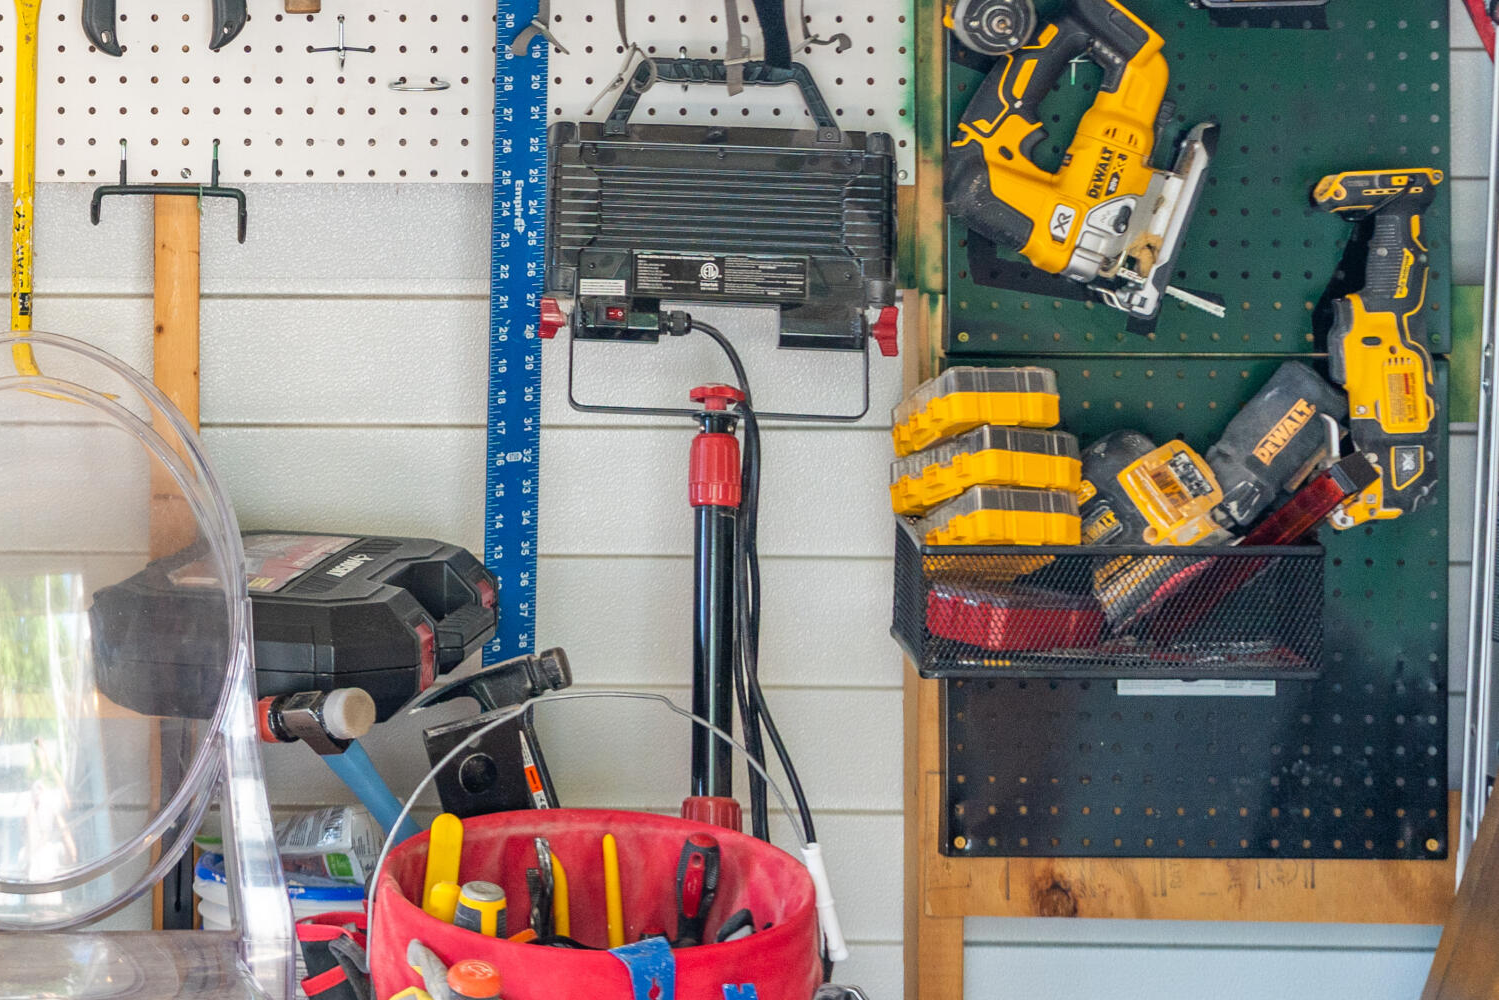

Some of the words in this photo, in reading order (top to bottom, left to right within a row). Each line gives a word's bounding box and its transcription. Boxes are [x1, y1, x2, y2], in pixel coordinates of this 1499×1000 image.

[505, 13, 514, 28] 30
[504, 45, 513, 59] 29
[531, 44, 540, 58] 19
[504, 76, 513, 91] 28
[530, 75, 540, 89] 20
[503, 108, 512, 121] 27
[530, 106, 539, 119] 21
[502, 139, 511, 153] 26
[530, 137, 538, 152] 22
[502, 170, 511, 185] 25
[529, 168, 538, 183] 23
[1087, 147, 1113, 199] DEWALT
[501, 201, 510, 216] 24
[513, 180, 524, 231] Empire
[528, 200, 537, 215] 24
[1054, 212, 1073, 234] XR
[500, 233, 509, 248] 23
[528, 231, 536, 245] 25
[500, 264, 509, 279] 22
[527, 262, 536, 277] 26
[499, 295, 508, 309] 21
[526, 293, 535, 307] 27
[499, 326, 508, 341] 20
[525, 324, 534, 339] 28
[498, 359, 507, 373] 19
[525, 355, 534, 370] 29
[497, 390, 506, 404] 18
[524, 387, 533, 401] 30
[496, 420, 505, 434] 17
[523, 417, 532, 431] 31
[1257, 400, 1315, 462] DEWALT
[495, 452, 504, 466] 16
[523, 448, 532, 463] 32
[495, 483, 504, 497] 15
[522, 479, 531, 494] 33
[495, 514, 503, 528] 14
[521, 510, 530, 525] 34
[494, 546, 502, 558] 13
[521, 541, 530, 555] 35
[520, 571, 529, 587] 36
[519, 602, 528, 616] 37
[491, 638, 500, 651] 10
[518, 633, 527, 648] 38
